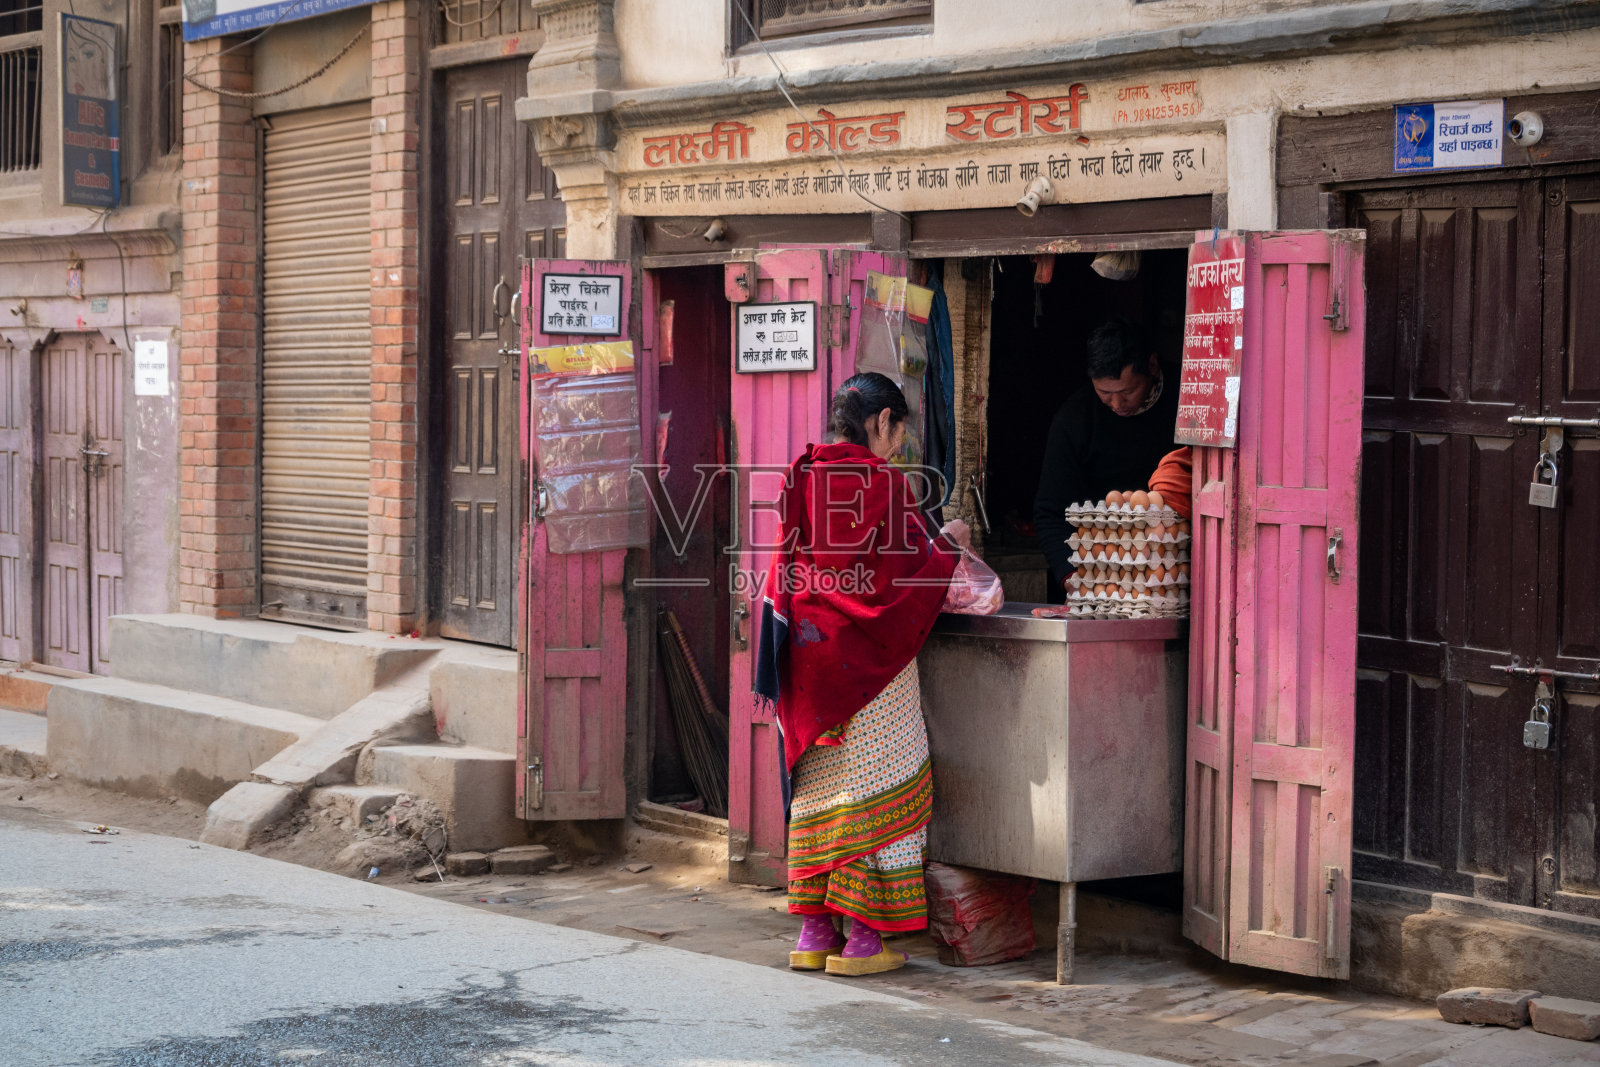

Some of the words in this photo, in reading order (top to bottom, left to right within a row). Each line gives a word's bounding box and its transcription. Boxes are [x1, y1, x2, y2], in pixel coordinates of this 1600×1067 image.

[1160, 80, 1197, 102] सुन्धारा
[1439, 122, 1469, 137] रिचार्ज
[1472, 121, 1493, 134] कार्ड
[642, 121, 754, 169] लक्ष्मी
[786, 108, 905, 155] कोल्ड
[1439, 138, 1458, 153] यहाँ
[683, 184, 696, 203] तथा
[987, 164, 1012, 186] ताजा
[1047, 153, 1072, 181] छिटो
[1078, 156, 1105, 178] भन्दा
[1111, 148, 1135, 177] छिटो
[1139, 151, 1165, 177] तयार
[579, 280, 611, 296] चिकेन
[548, 312, 564, 327] प्रति
[744, 313, 767, 324] अण्डा
[771, 309, 786, 324] प्रति
[791, 308, 806, 323] क्रेट
